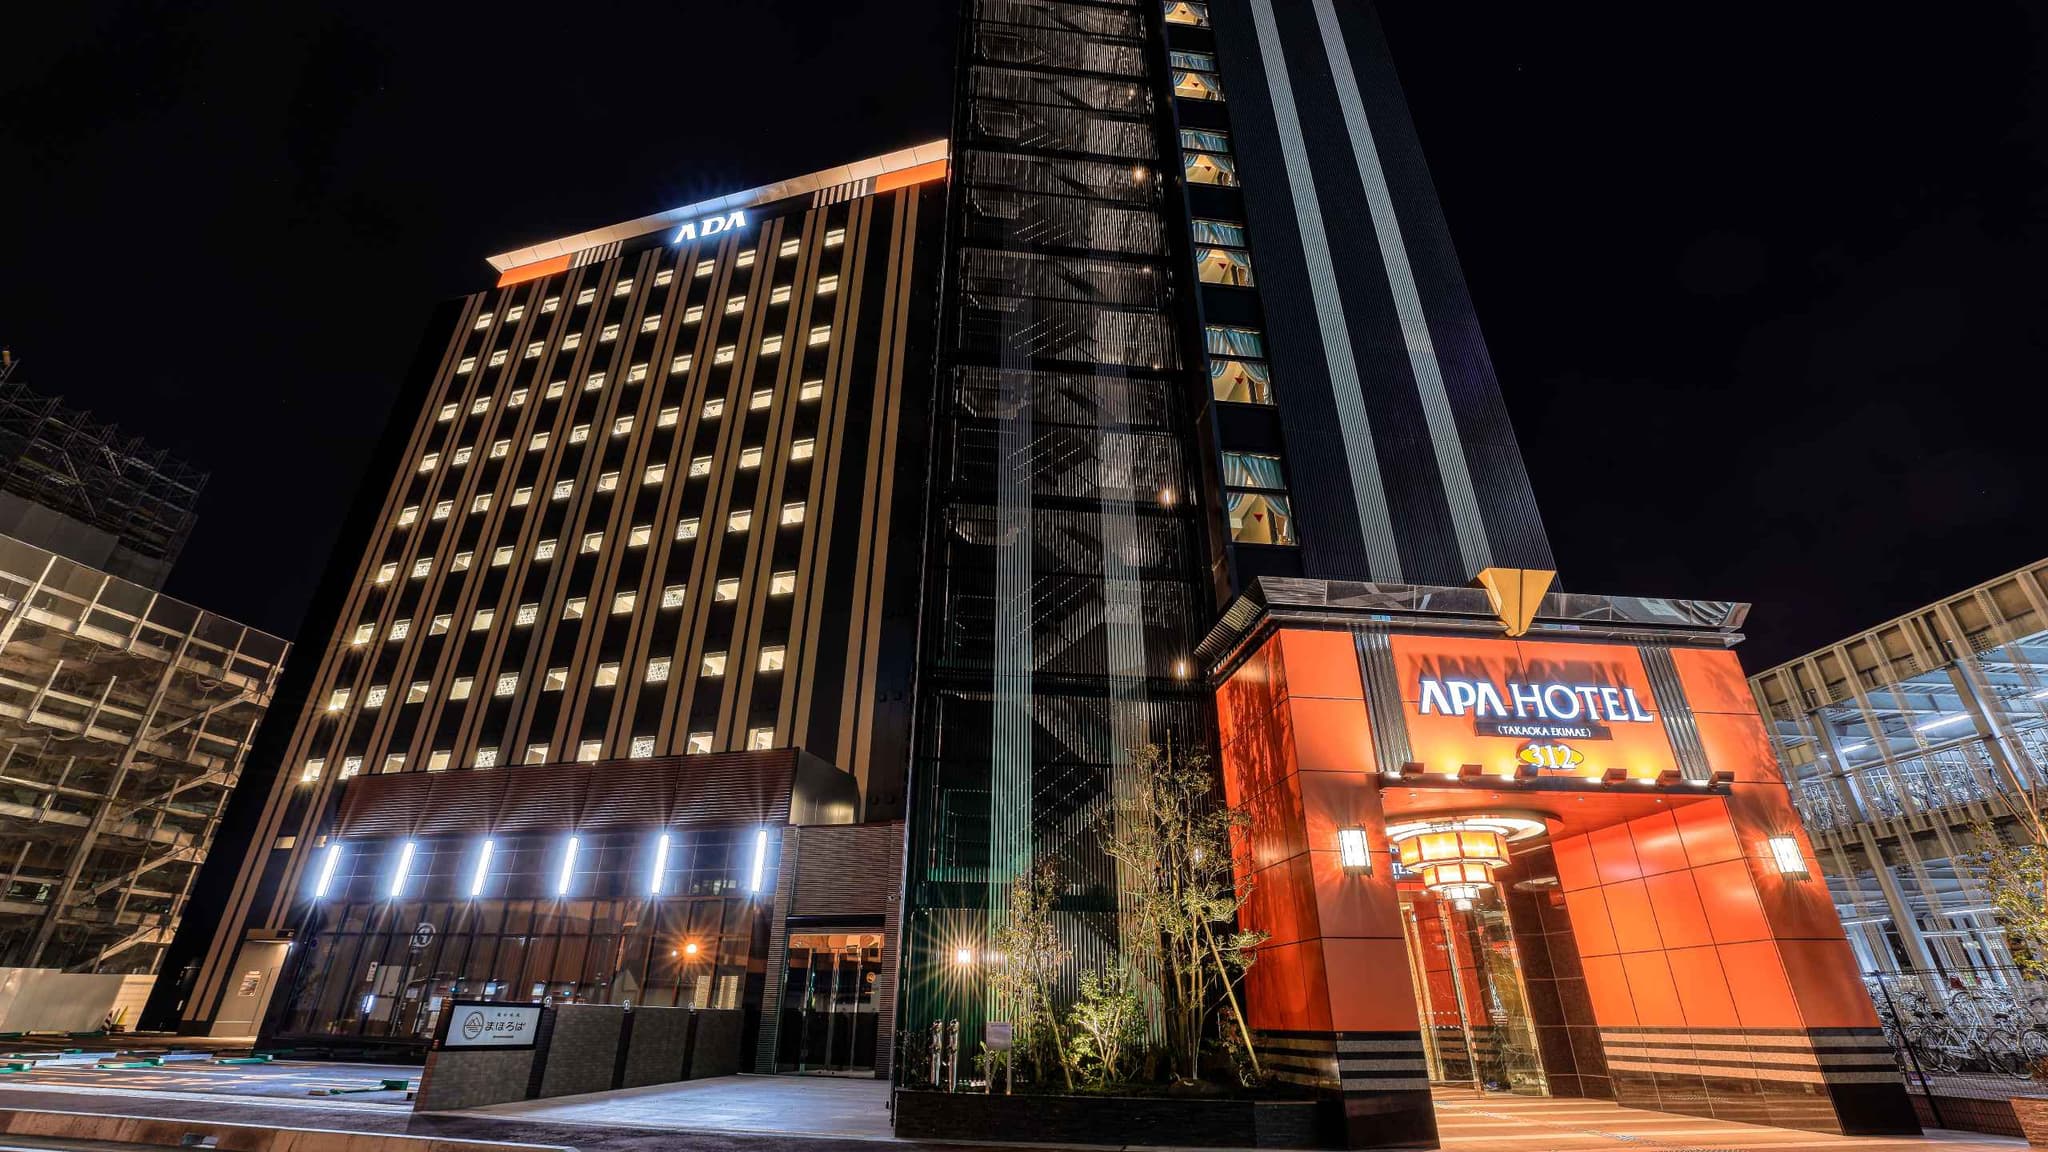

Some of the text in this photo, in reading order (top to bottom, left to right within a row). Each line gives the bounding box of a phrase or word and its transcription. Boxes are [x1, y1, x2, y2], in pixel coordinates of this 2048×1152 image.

[1422, 680, 1654, 722] APA HOTEL
[1529, 744, 1575, 769] 312
[485, 1021, 526, 1032] まほろば
